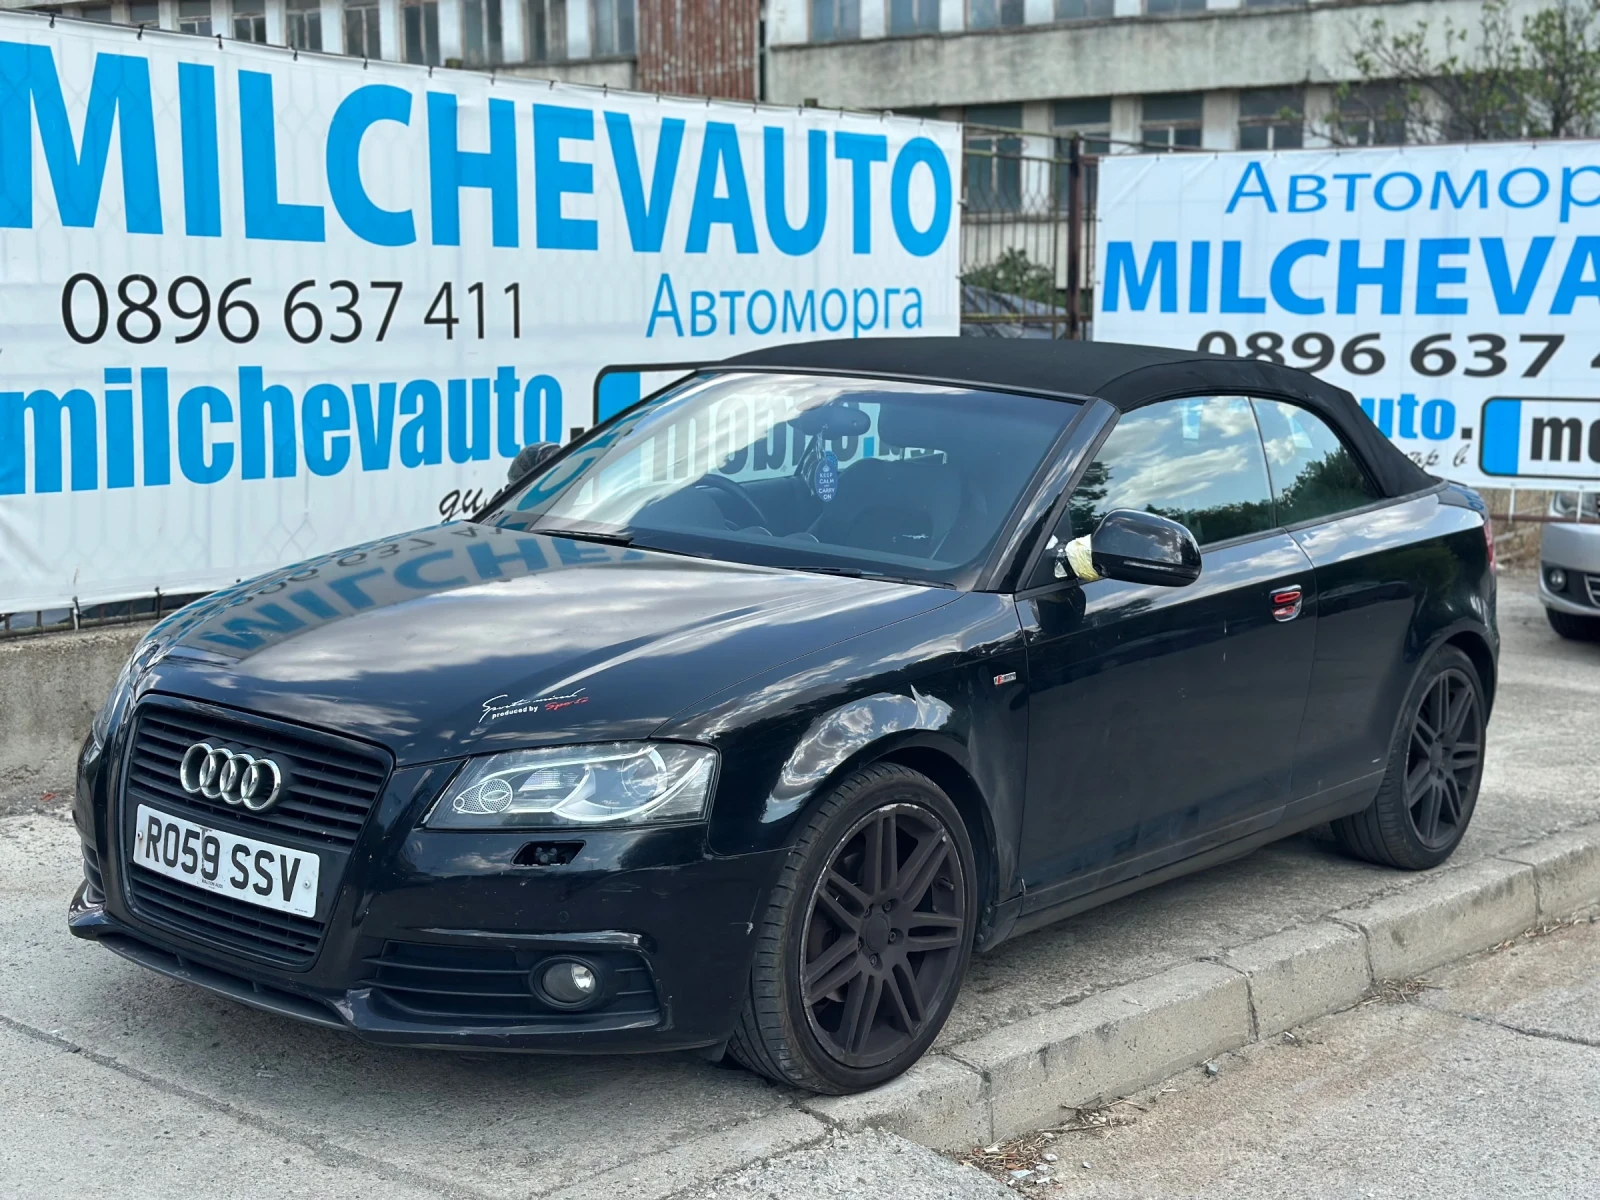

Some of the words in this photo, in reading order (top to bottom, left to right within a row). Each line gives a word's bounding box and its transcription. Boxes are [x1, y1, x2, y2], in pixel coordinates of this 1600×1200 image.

[0, 41, 952, 256] MILCHEVAUTO
[1225, 161, 1600, 223] Автомор
[61, 272, 260, 344] 0896
[283, 279, 403, 343] 637
[424, 281, 522, 340] 411
[645, 273, 923, 338] Автоморга
[1409, 332, 1565, 378] 637
[492, 706, 527, 719] produced
[529, 705, 539, 713] by
[145, 815, 220, 881] RO59
[229, 843, 301, 902] SSV
